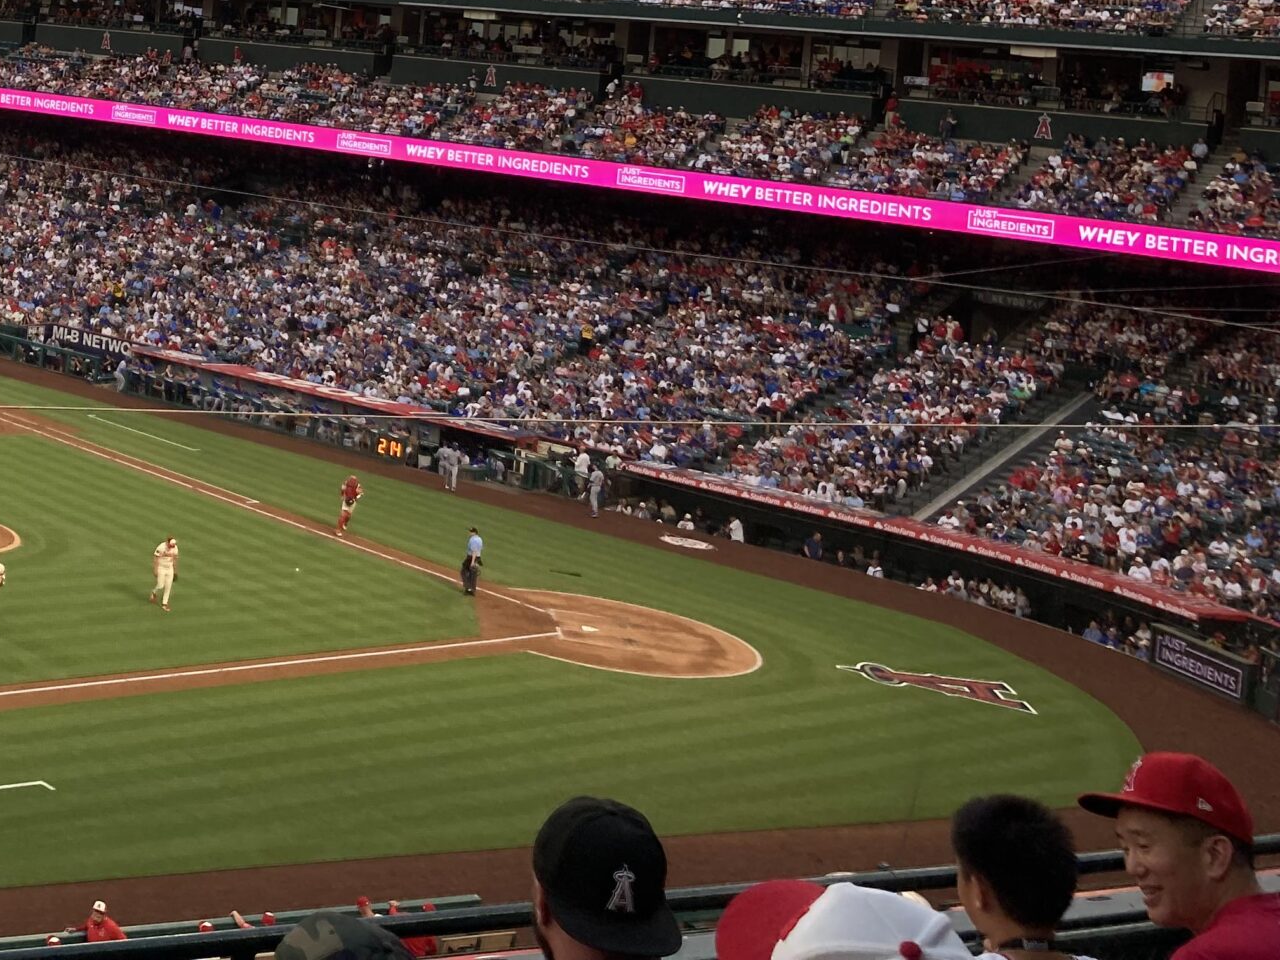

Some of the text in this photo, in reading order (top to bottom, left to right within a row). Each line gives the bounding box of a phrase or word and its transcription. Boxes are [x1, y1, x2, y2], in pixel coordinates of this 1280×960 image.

[0, 93, 31, 107] BETTER
[33, 97, 94, 114] INGREDIENTS
[114, 111, 154, 122] INGREDIENTS
[168, 114, 315, 143] WHEY BETTER INGREDIENTS
[341, 140, 388, 153] INGREDIENTS
[406, 143, 589, 178] WHEY BETTER INGREDIENTS
[623, 167, 640, 175] JUST
[621, 174, 681, 190] INGREDIENTS
[703, 180, 932, 221] WHEY BETTER INGREDIENTS
[973, 209, 998, 219] JUST
[972, 217, 1049, 235] INGREDIENTS
[1078, 225, 1141, 246] WHEY
[1145, 233, 1218, 257] BETTER
[53, 325, 79, 343] MLB
[1162, 635, 1187, 653] JUST
[1161, 648, 1237, 690] INGREDIENTS
